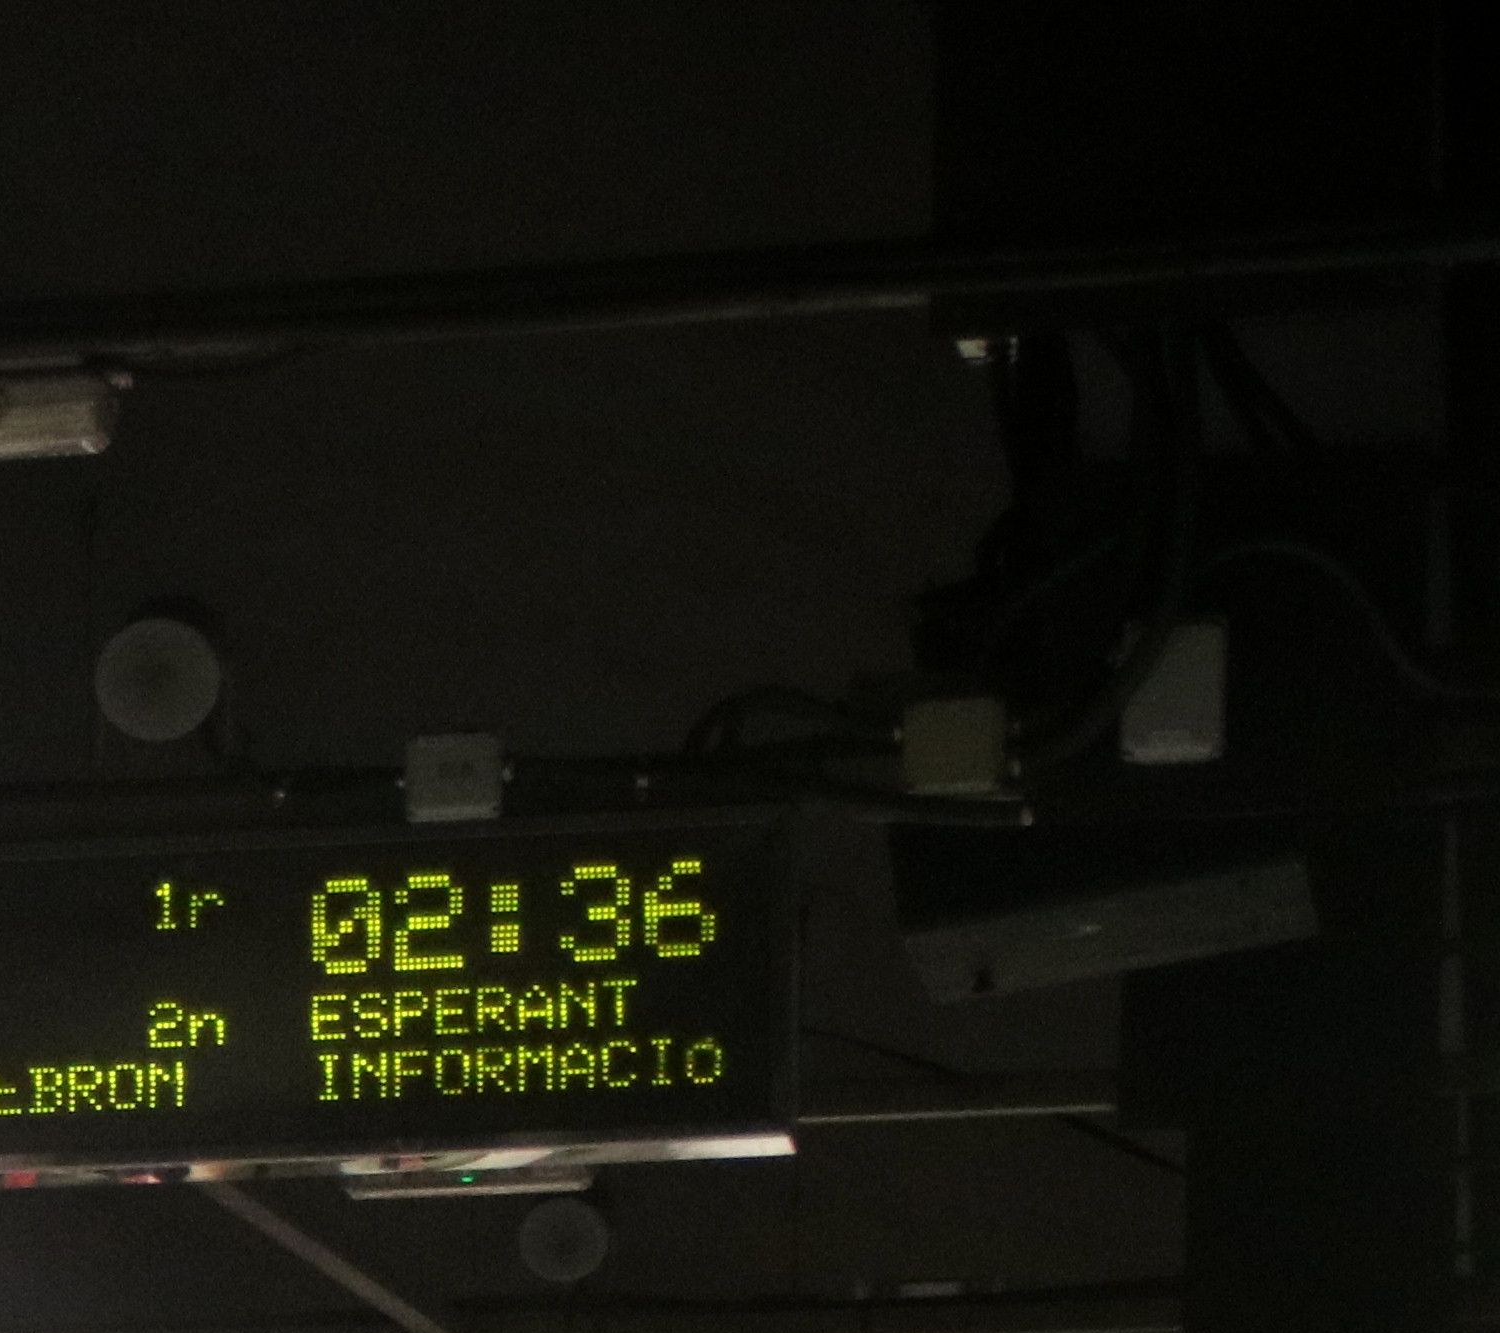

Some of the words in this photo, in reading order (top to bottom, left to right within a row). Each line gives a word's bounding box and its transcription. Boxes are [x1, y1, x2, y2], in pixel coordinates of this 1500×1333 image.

[155, 882, 225, 931] 1r
[311, 859, 717, 976] 02:36
[148, 1002, 226, 1050] 2n
[311, 979, 638, 1041] ESPERANT
